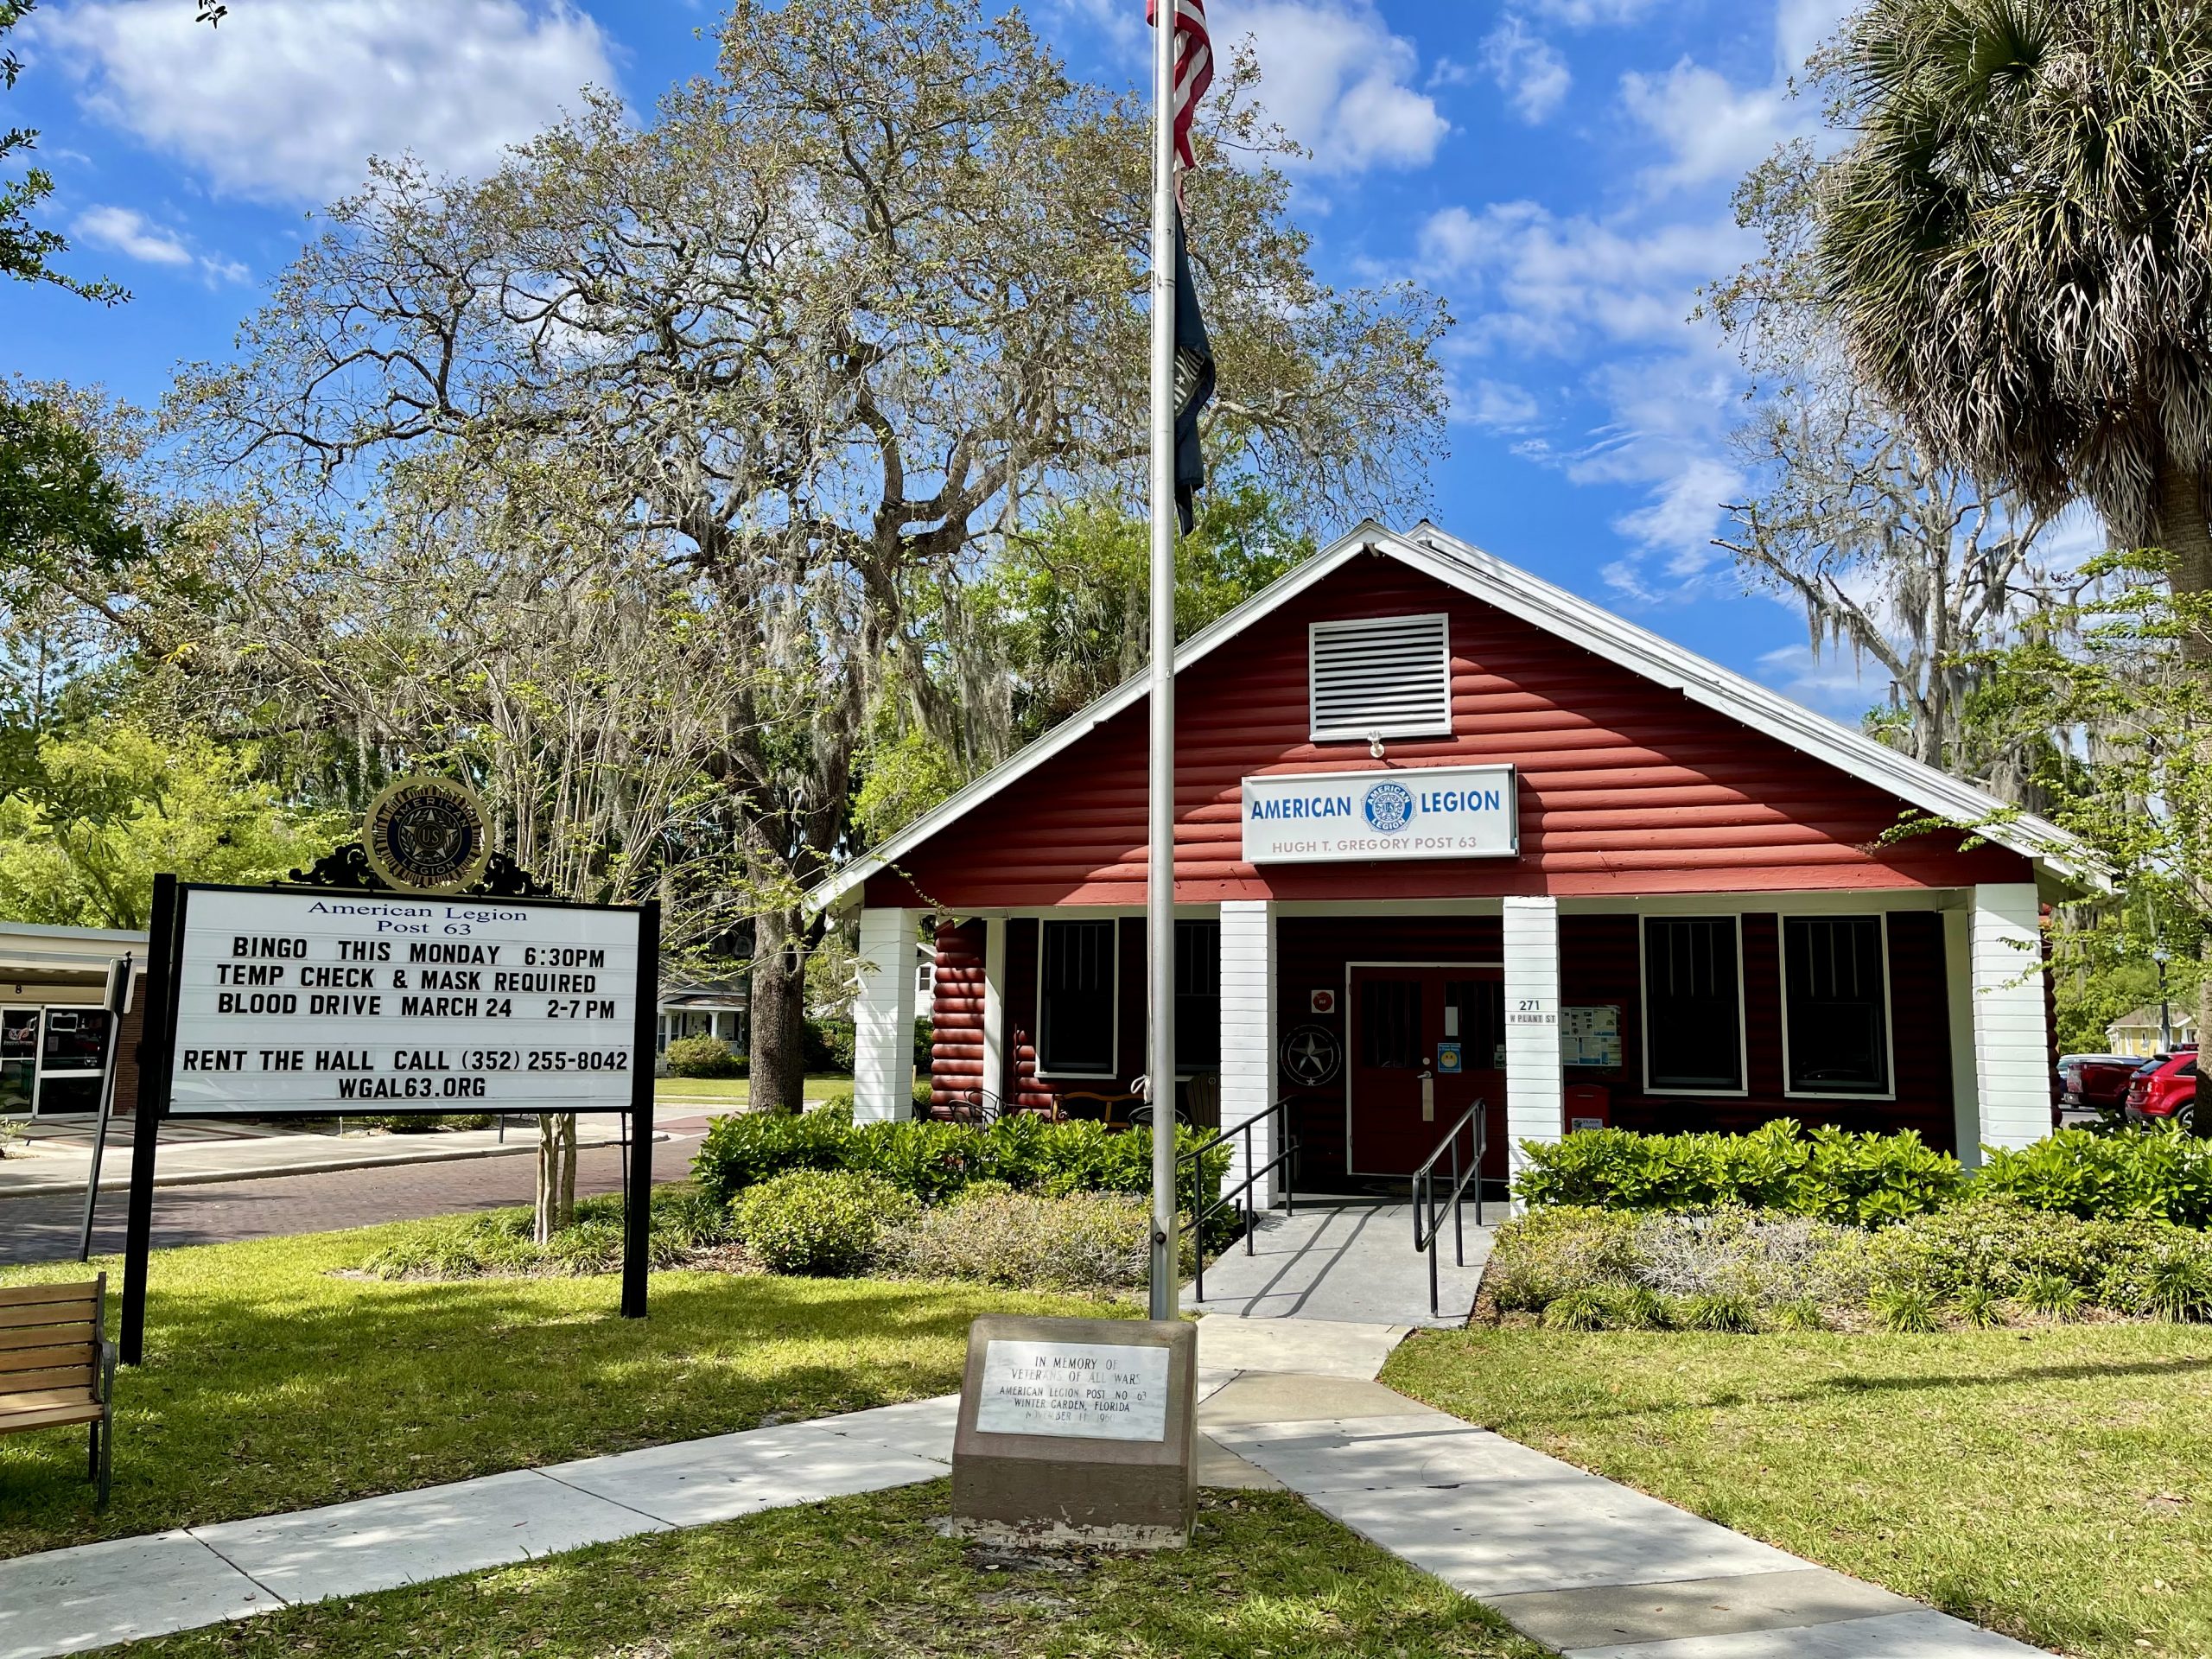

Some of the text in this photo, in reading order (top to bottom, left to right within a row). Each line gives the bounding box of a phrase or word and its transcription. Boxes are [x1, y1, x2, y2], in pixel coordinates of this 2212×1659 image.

[1367, 785, 1410, 805] AMERICAN
[393, 797, 469, 828] AMERICAN
[1251, 790, 1500, 820] AMERICAN LEGION
[1371, 817, 1406, 830] LEGION
[423, 829, 440, 843] US
[1272, 836, 1478, 854] HUGH T. GREGORY POST 63
[401, 858, 456, 875] LEGION
[308, 900, 528, 923] American Legion
[375, 920, 472, 936] Post 63
[233, 937, 605, 968] BINGO THIS MONDAY 6:30PM
[217, 963, 596, 994] TEMP CHECK & MASK REQUIRED
[15, 984, 22, 994] 8
[218, 993, 614, 1019] BLOOD DRIVE MARCH 24 2-7 PM
[1519, 1000, 1540, 1011] 271
[1510, 1014, 1556, 1023] W PLANT ST
[182, 1050, 627, 1071] RENT THE HALL CALL (352) 255-8042
[339, 1077, 486, 1099] WGAL63.ORG
[1035, 1356, 1118, 1370] IN MEMORY OF
[1011, 1368, 1141, 1385] VETERANS OF ALL WARS
[999, 1386, 1044, 1396] AMERICAN
[1049, 1388, 1079, 1398] LEGION
[1086, 1389, 1105, 1399] POST
[1014, 1398, 1130, 1413] WINTER GARDEN, FLORIDA
